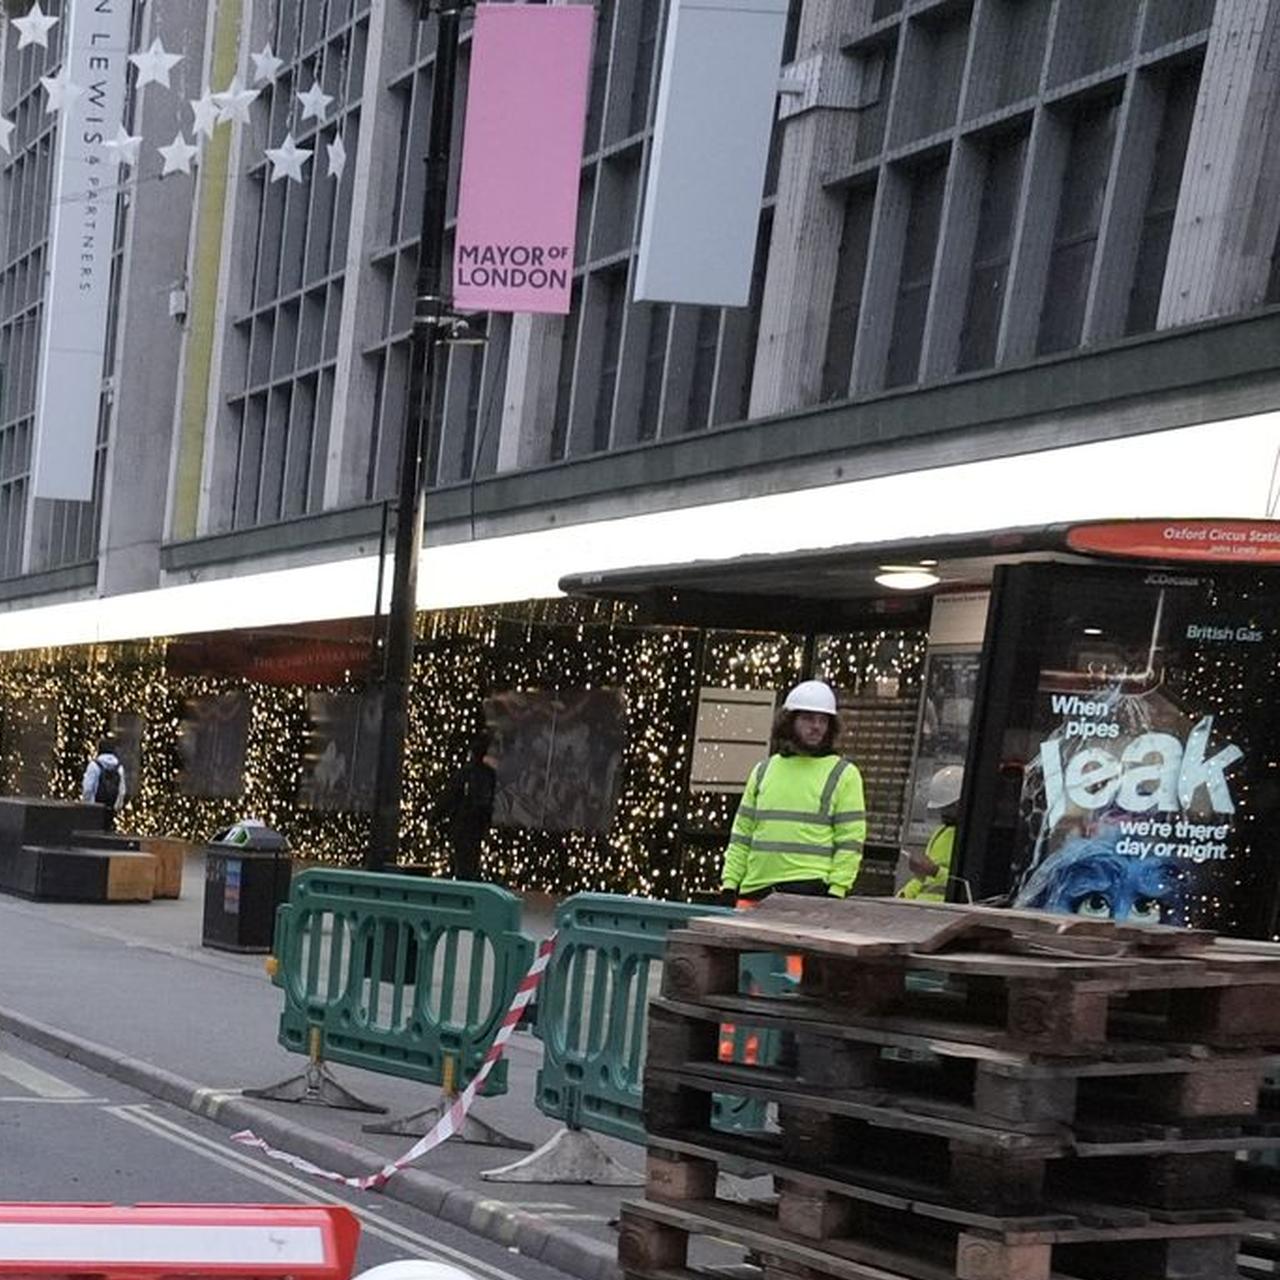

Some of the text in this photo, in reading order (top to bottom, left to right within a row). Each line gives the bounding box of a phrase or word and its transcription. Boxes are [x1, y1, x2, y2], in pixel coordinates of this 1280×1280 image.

[84, 33, 112, 145] LEWIS
[79, 177, 100, 292] PARTNERS
[459, 245, 568, 266] MAYOR OF
[458, 267, 567, 289] LONDON
[1164, 527, 1207, 541] Oxford
[1209, 528, 1246, 542] Circus
[1187, 625, 1263, 642] British Gas
[1052, 695, 1109, 716] When
[1066, 717, 1119, 739] pipes
[1040, 715, 1244, 830] leak
[1120, 820, 1228, 840] we're there
[1116, 838, 1227, 863] day or night
